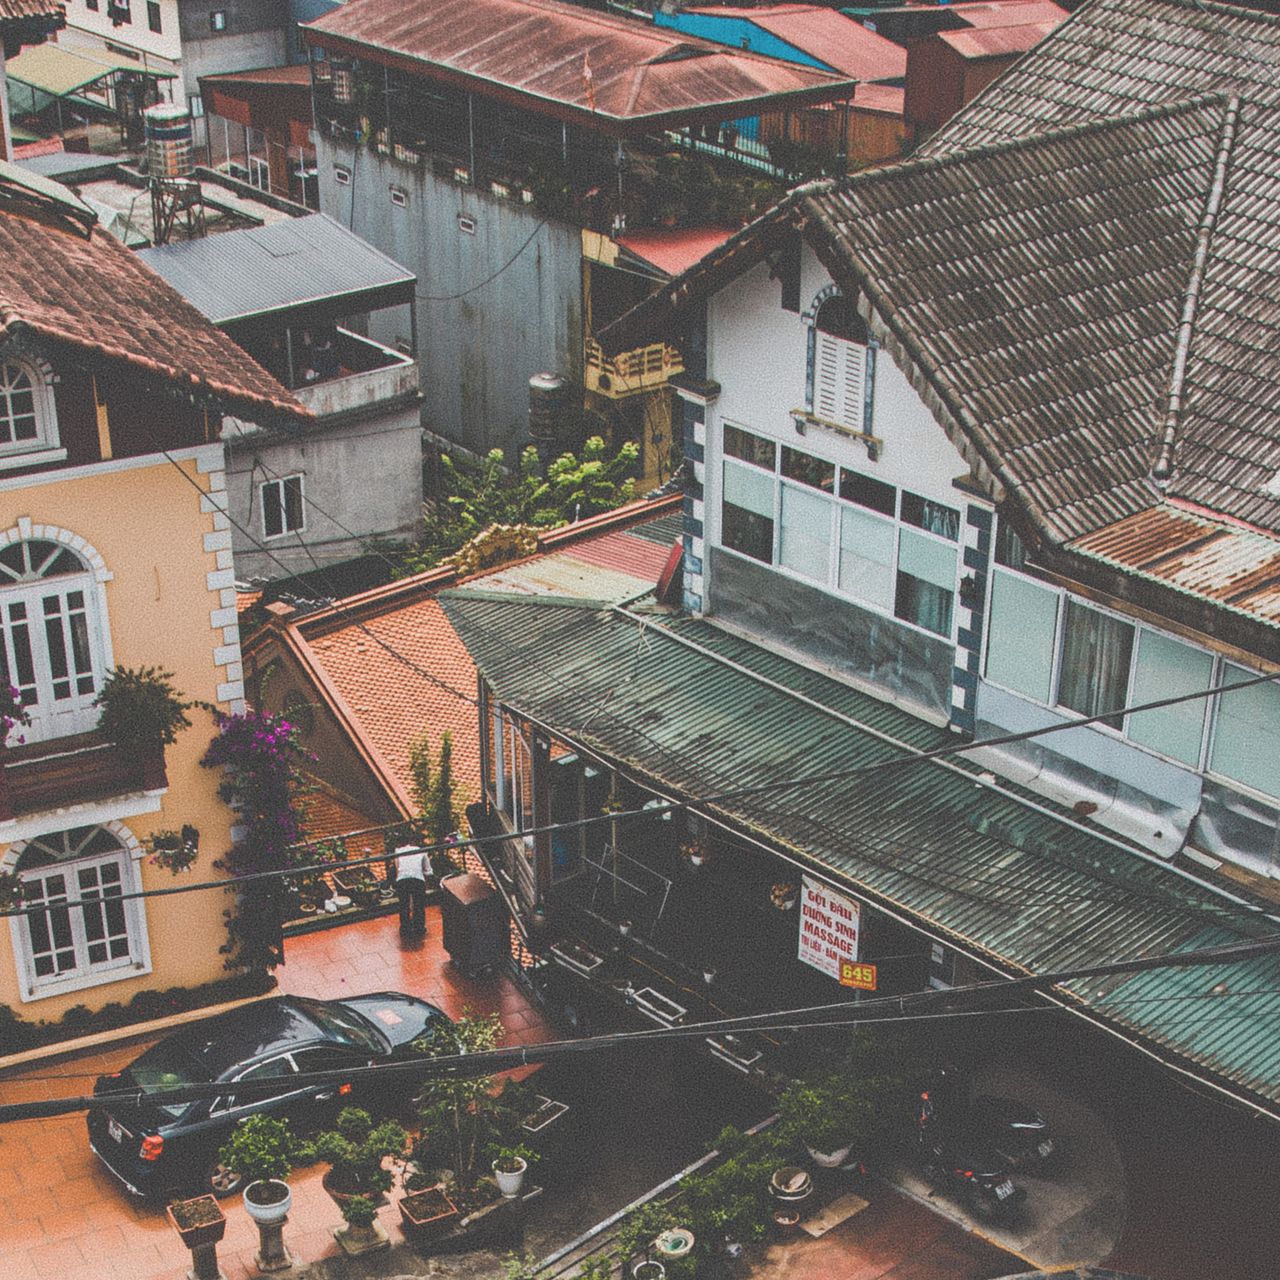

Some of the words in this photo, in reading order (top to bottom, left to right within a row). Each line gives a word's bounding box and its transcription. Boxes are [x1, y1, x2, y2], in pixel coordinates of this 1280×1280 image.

[804, 921, 854, 956] MASSAGE
[835, 921, 857, 941] SINH
[843, 964, 873, 982] 645
